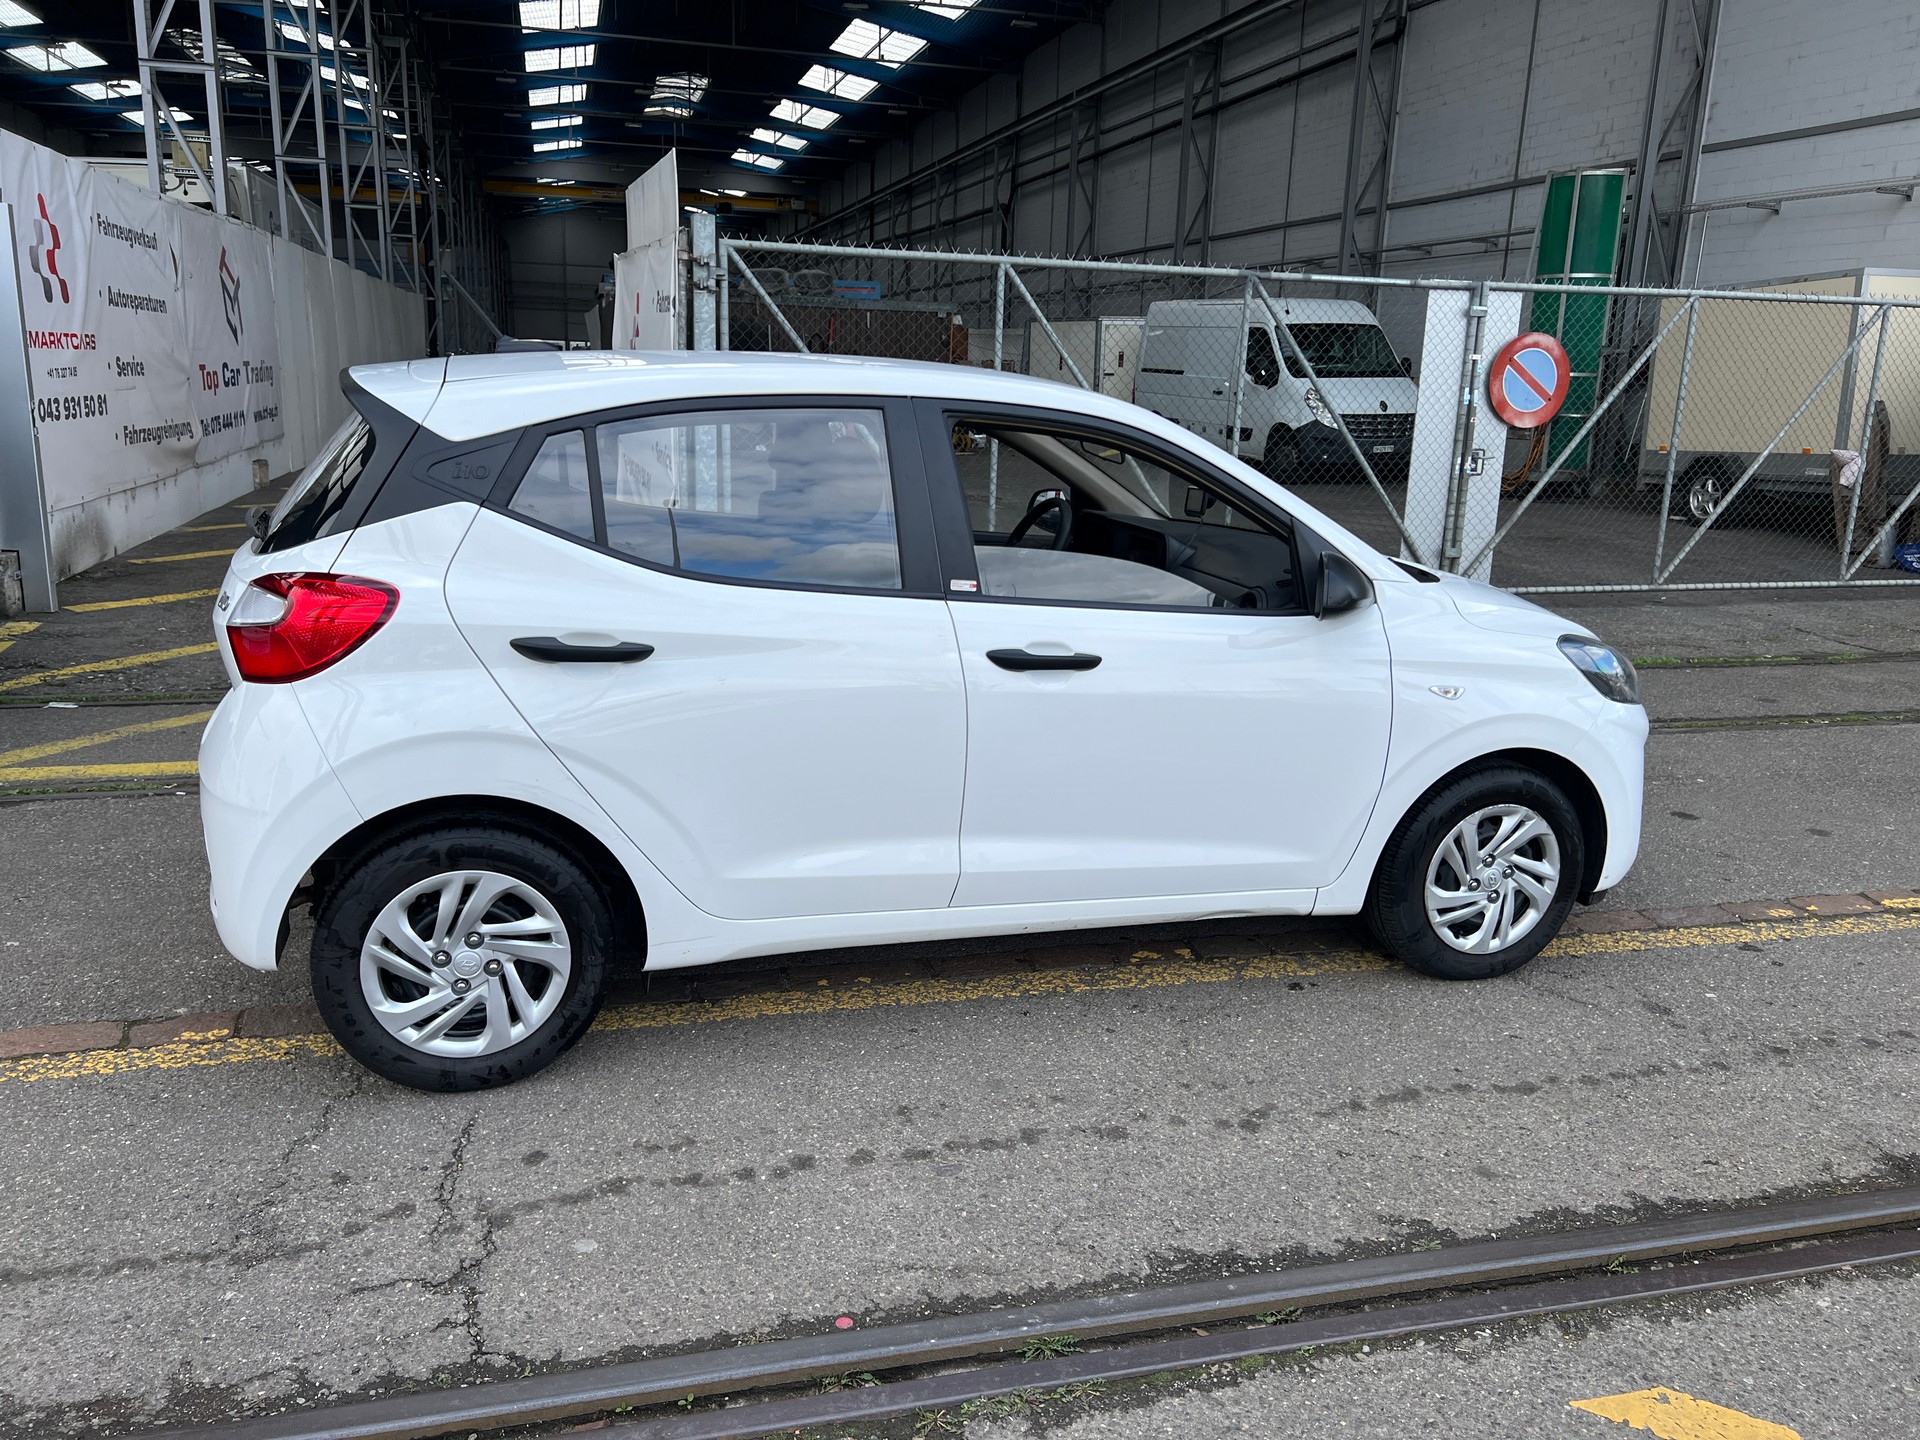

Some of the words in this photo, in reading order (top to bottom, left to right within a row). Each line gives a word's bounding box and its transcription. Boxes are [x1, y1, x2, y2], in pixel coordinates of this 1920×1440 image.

[96, 212, 158, 251] Fahrzeugverkauf
[107, 285, 168, 315] Autoreparaturen
[115, 354, 145, 378] Service
[198, 363, 219, 396] Top
[222, 361, 241, 388] Car
[242, 359, 274, 387] Trading
[37, 397, 61, 423] 043
[63, 396, 82, 420] 931
[83, 394, 96, 418] 50
[97, 393, 108, 416] 81
[222, 411, 233, 431] 444
[123, 418, 194, 446] Fahrzeugreinigung
[451, 461, 490, 480] i10
